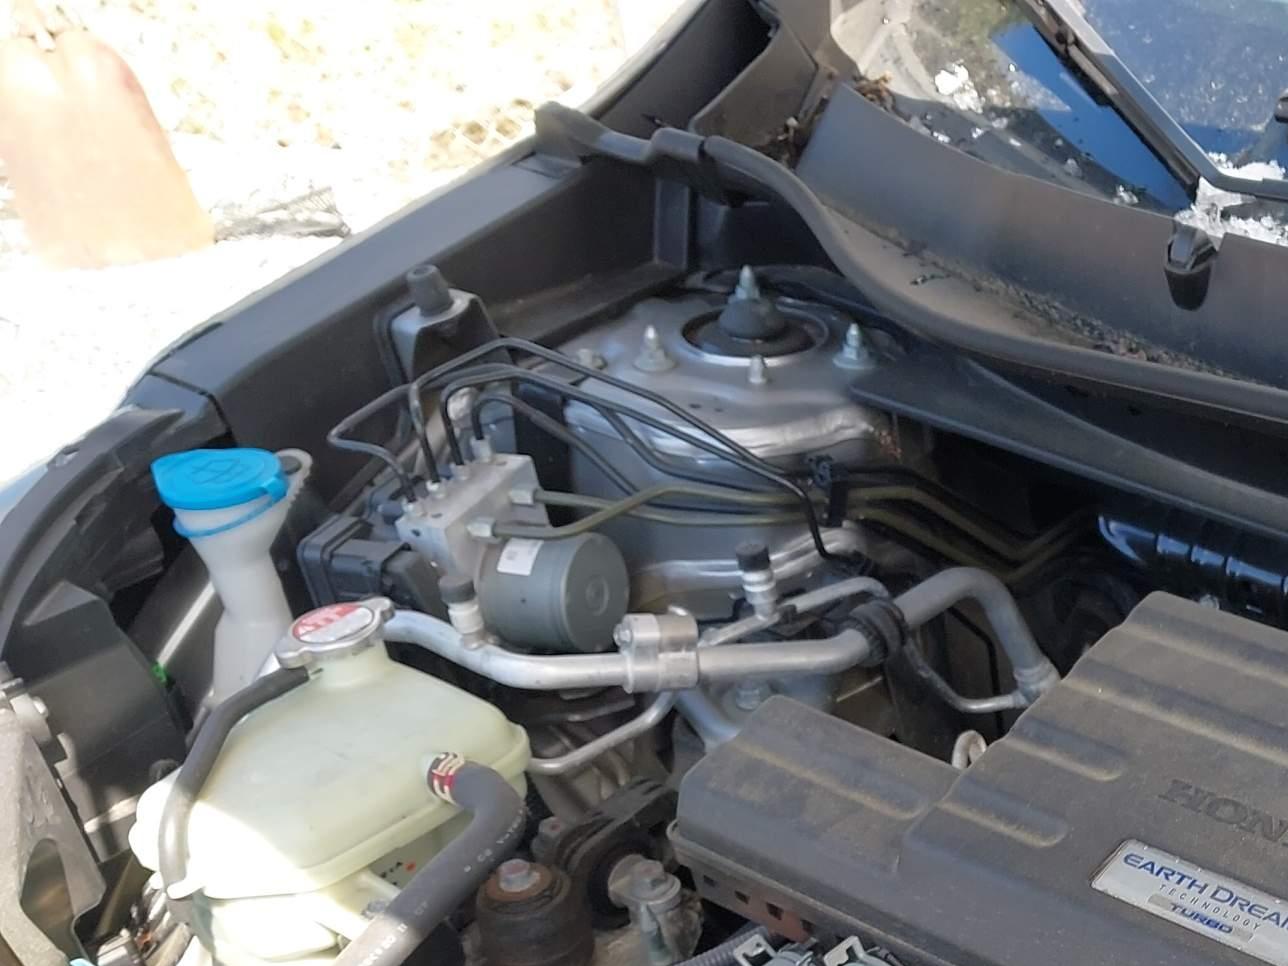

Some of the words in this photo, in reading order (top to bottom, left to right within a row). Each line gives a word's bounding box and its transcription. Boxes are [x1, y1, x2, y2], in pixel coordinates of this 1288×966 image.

[1122, 852, 1209, 895] EARTH
[1159, 883, 1262, 931] TECHNOLOGY
[1170, 902, 1234, 934] TURBO
